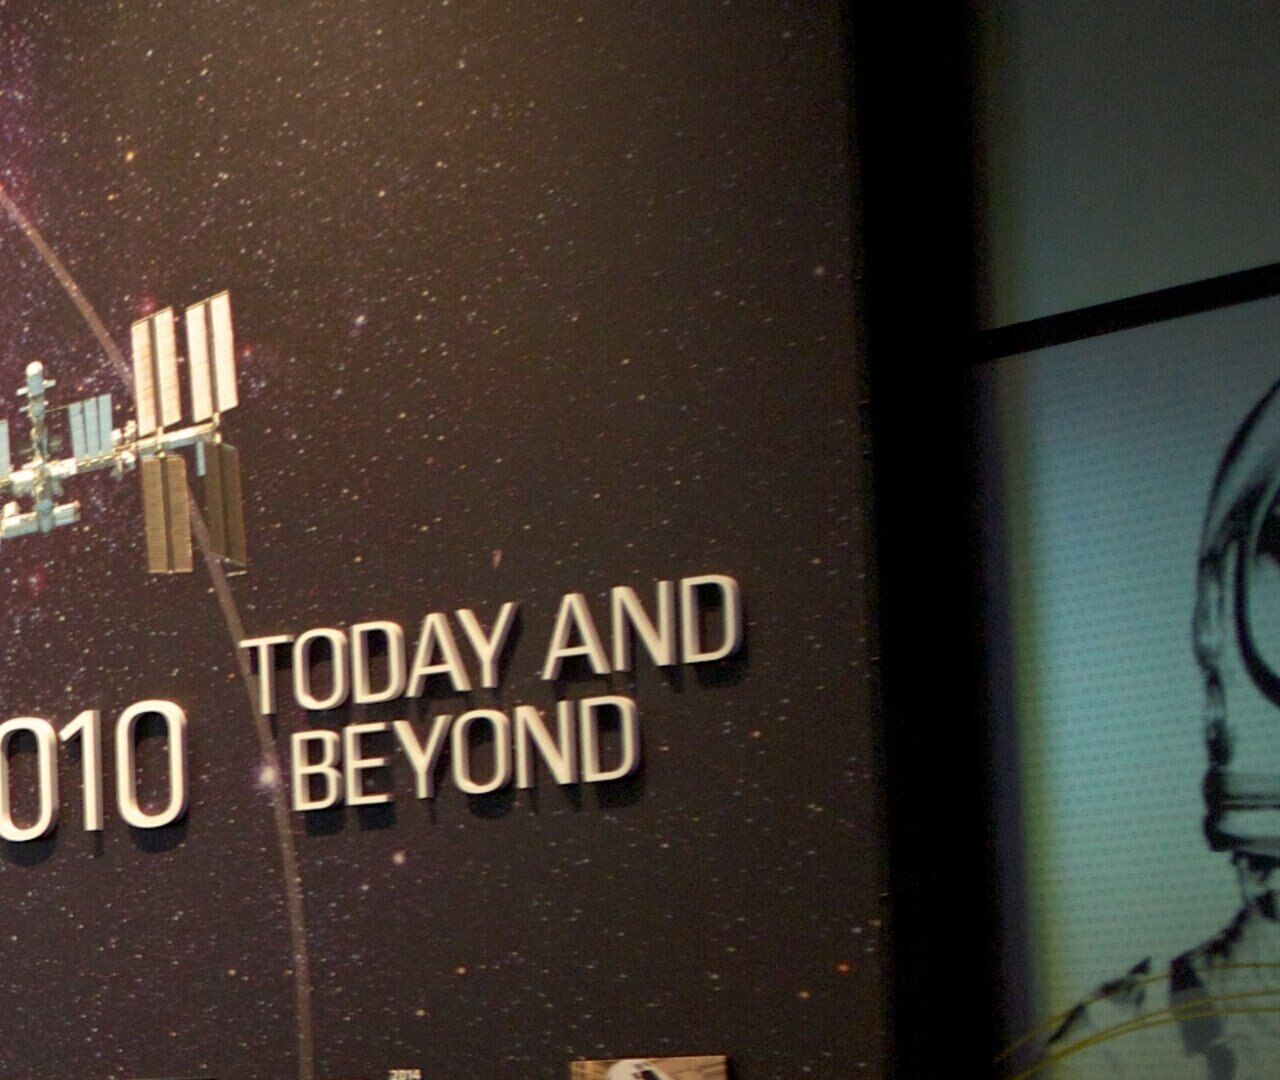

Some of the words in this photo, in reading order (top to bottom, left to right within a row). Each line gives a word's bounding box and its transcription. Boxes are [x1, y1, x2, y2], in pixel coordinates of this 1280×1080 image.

[241, 602, 519, 716] TODAY
[543, 573, 743, 683] AND
[293, 695, 642, 813] BEYOND
